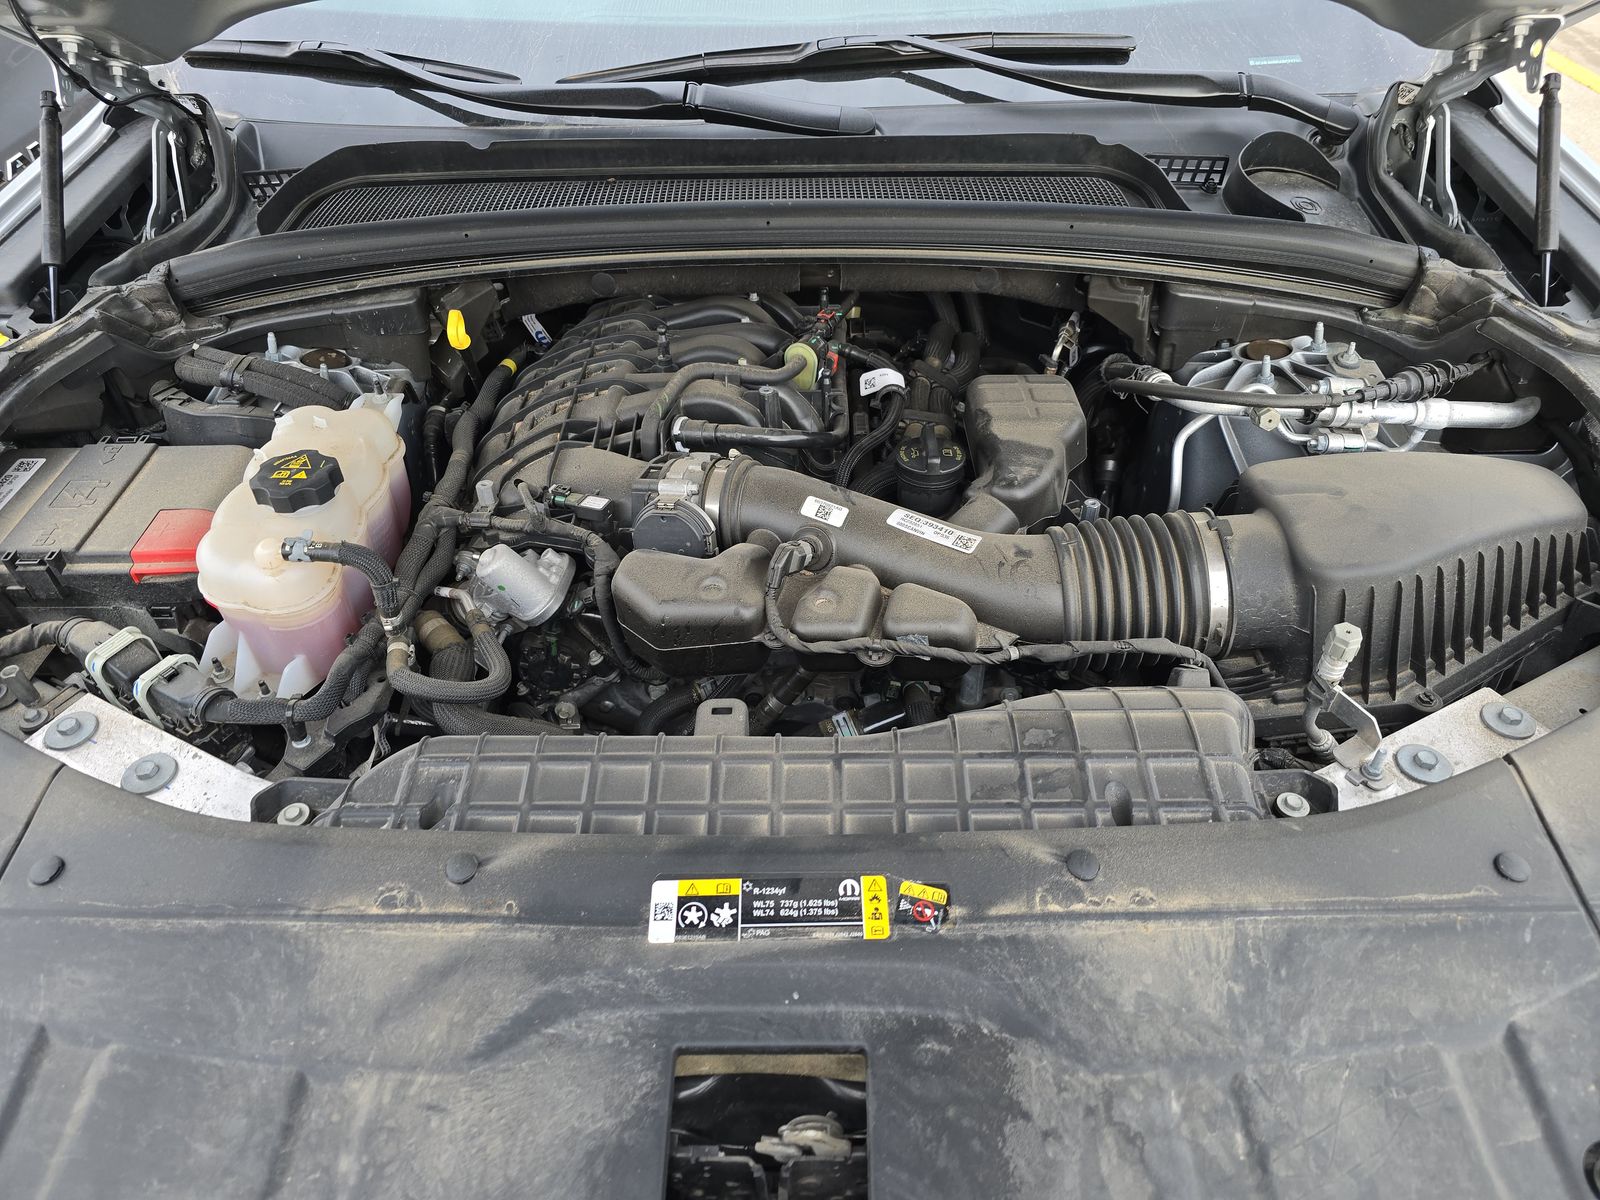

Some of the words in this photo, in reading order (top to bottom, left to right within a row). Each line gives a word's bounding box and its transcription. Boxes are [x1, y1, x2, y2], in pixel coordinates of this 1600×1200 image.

[752, 900, 775, 908] WL75
[780, 899, 799, 909] 737g
[823, 899, 839, 908] lbs)
[752, 908, 775, 917] WL74
[780, 908, 799, 918] 624g
[799, 908, 823, 917] (1.375
[823, 907, 839, 917] lbs)
